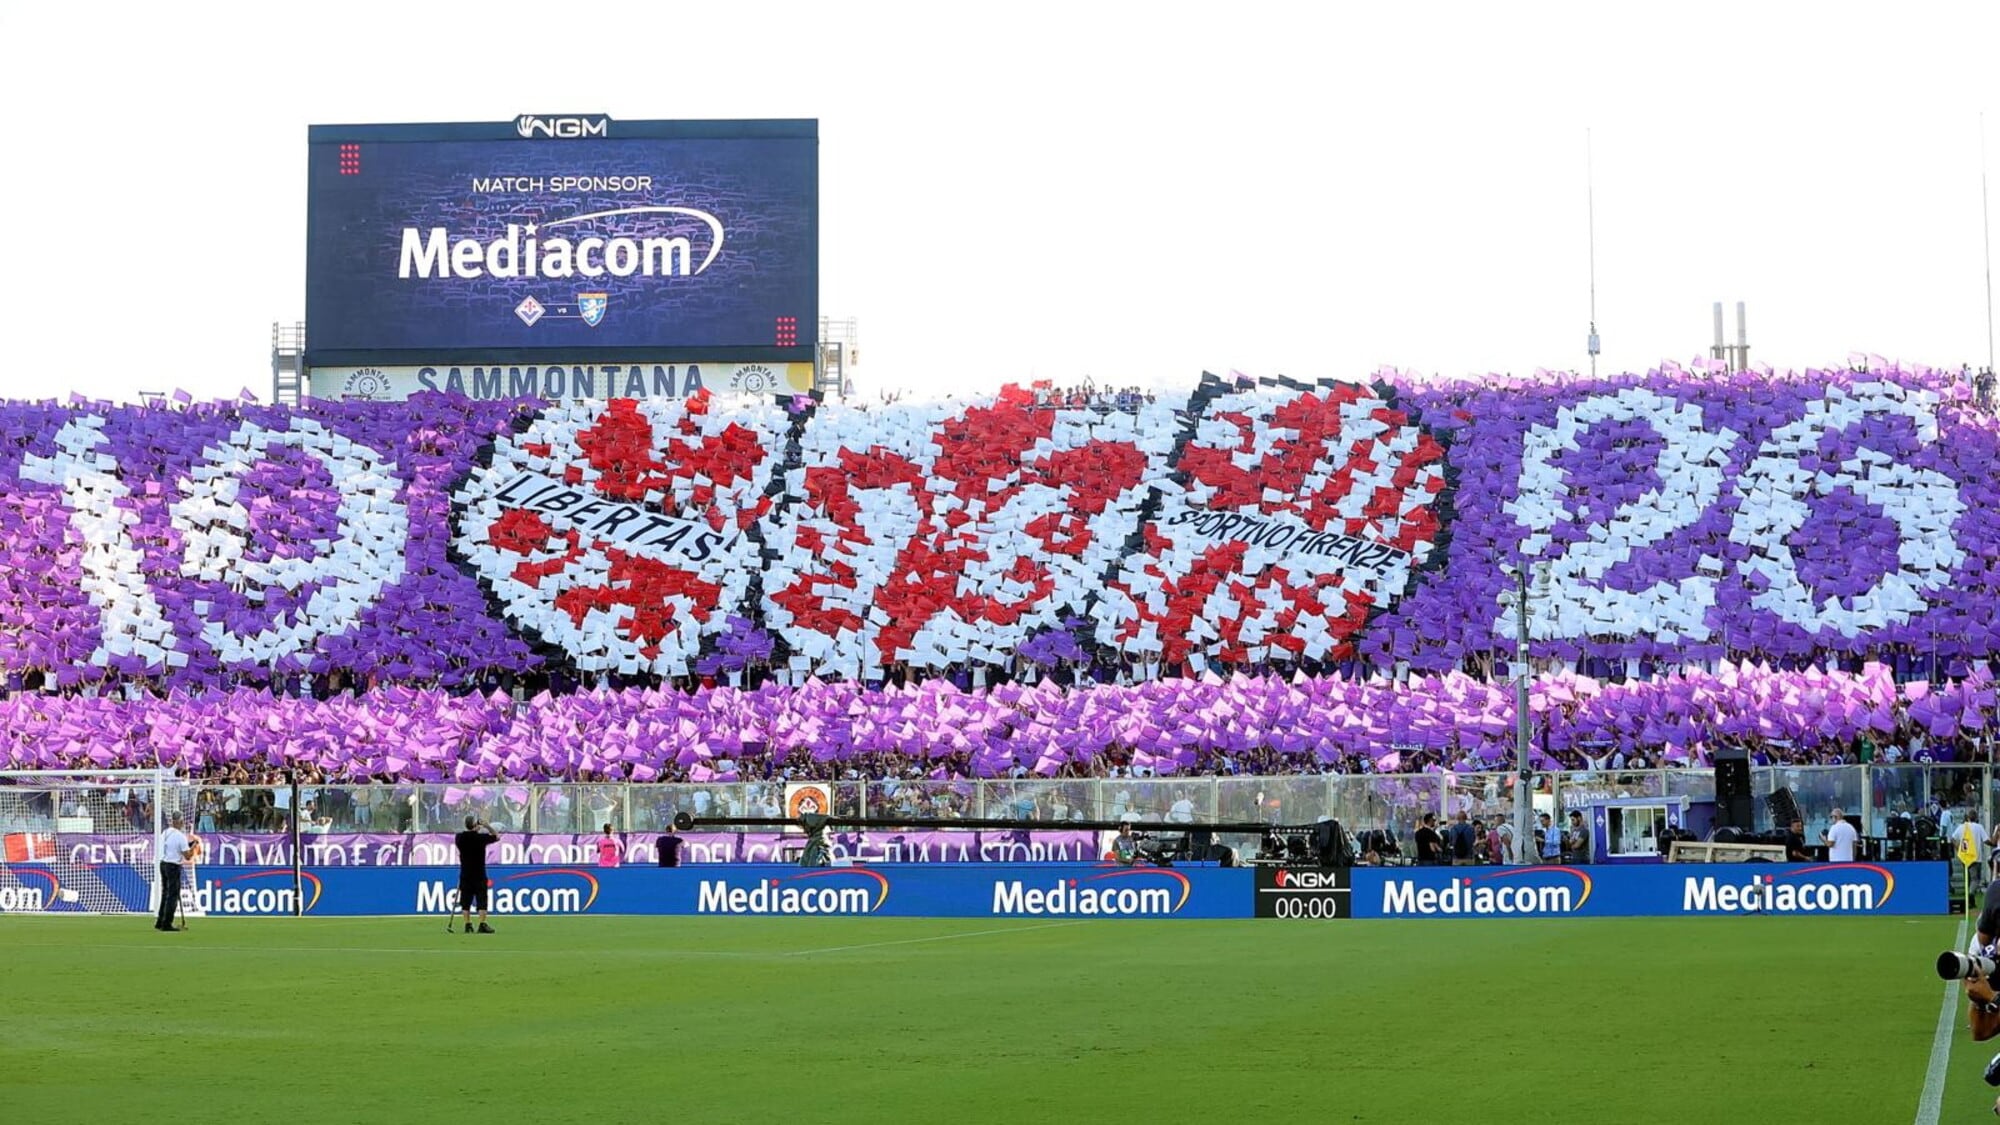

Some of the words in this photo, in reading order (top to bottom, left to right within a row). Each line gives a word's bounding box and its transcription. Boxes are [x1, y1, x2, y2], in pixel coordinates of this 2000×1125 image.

[520, 116, 607, 138] NGM
[473, 178, 543, 192] MATCH
[550, 176, 652, 192] SPONSOR
[398, 222, 691, 278] Mediacom
[345, 368, 391, 391] SAMMONTANA
[417, 365, 704, 399] SAMMONTANA
[731, 364, 778, 388] SAMMONTANA
[494, 473, 724, 562] LIBERTAS
[1168, 510, 1296, 548] SPORTIVO
[1290, 529, 1405, 575] FIRENZE
[698, 879, 869, 914] Mediacom
[993, 879, 1170, 914] Mediacom
[1279, 871, 1336, 888] NGM
[1383, 877, 1571, 914] Mediacom
[1683, 875, 1873, 912] Mediacom
[1275, 897, 1337, 919] 00:00
